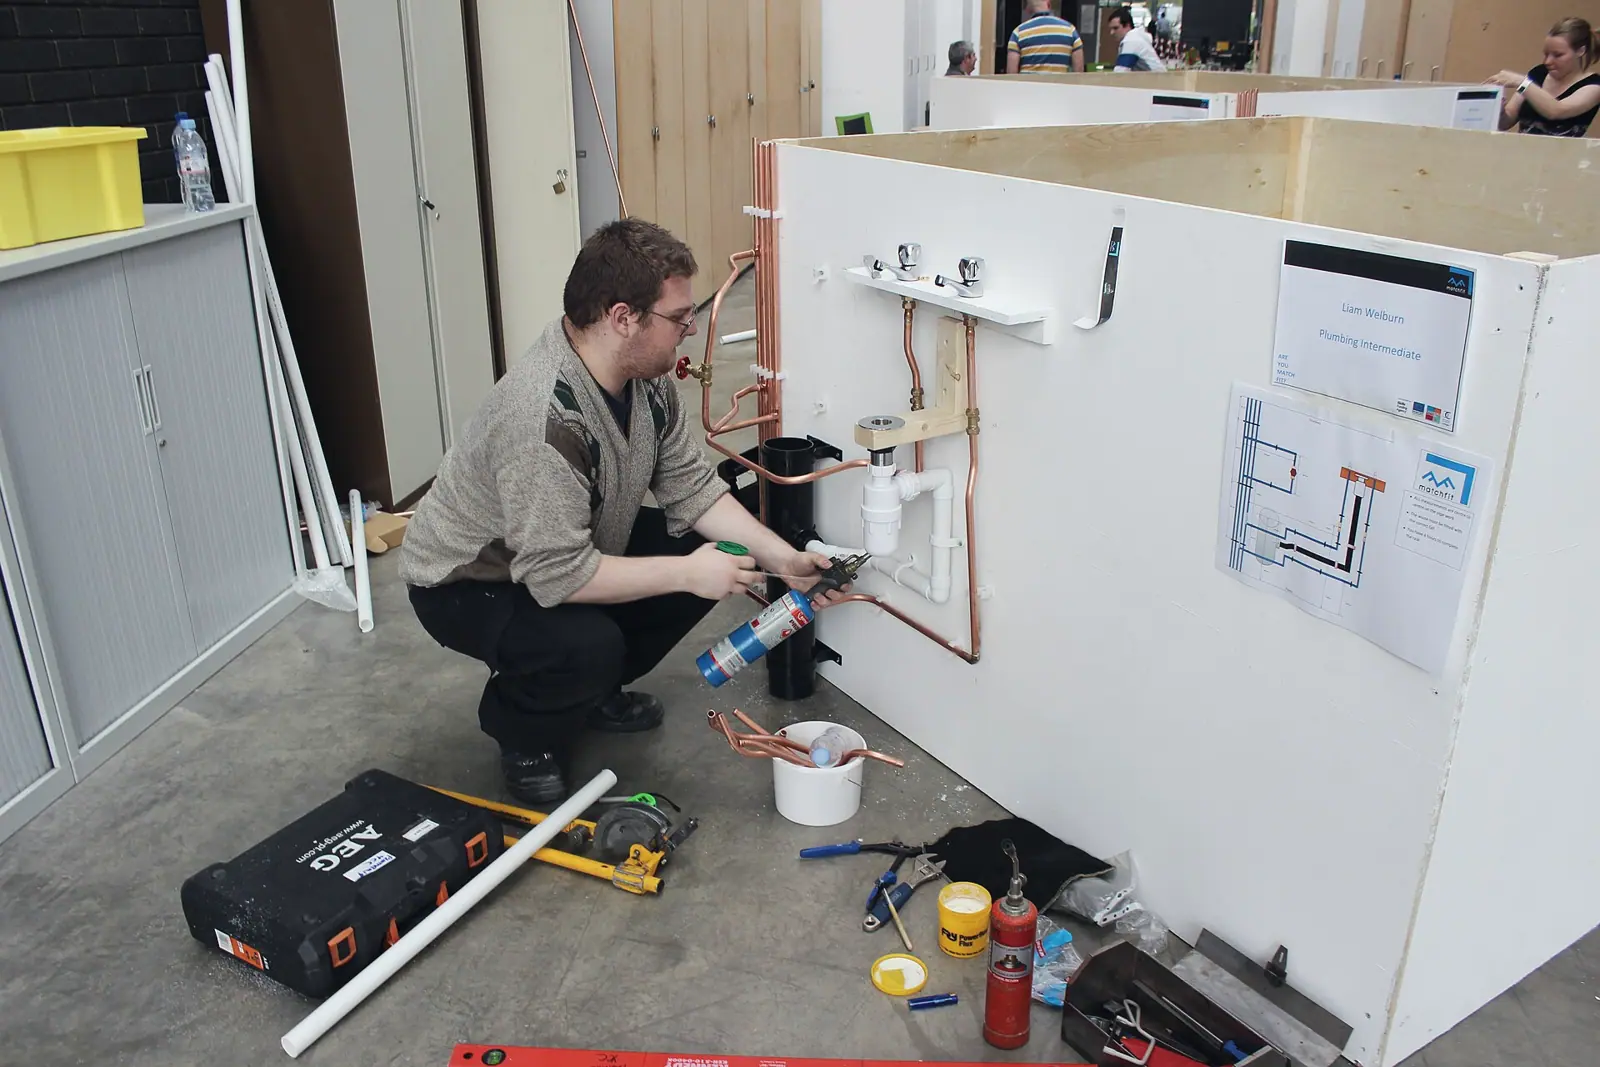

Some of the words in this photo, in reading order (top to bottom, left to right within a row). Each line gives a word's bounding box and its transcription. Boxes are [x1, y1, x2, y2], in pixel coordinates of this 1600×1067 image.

[1342, 303, 1363, 316] Liam
[1365, 308, 1404, 325] Welburn
[1319, 329, 1358, 348] Plumbing
[1360, 339, 1421, 361] Intermediate
[1277, 369, 1295, 378] MATCH
[1418, 484, 1454, 501] matchfit
[295, 819, 365, 863] www.aeg-pt.com
[310, 824, 383, 871] AEG
